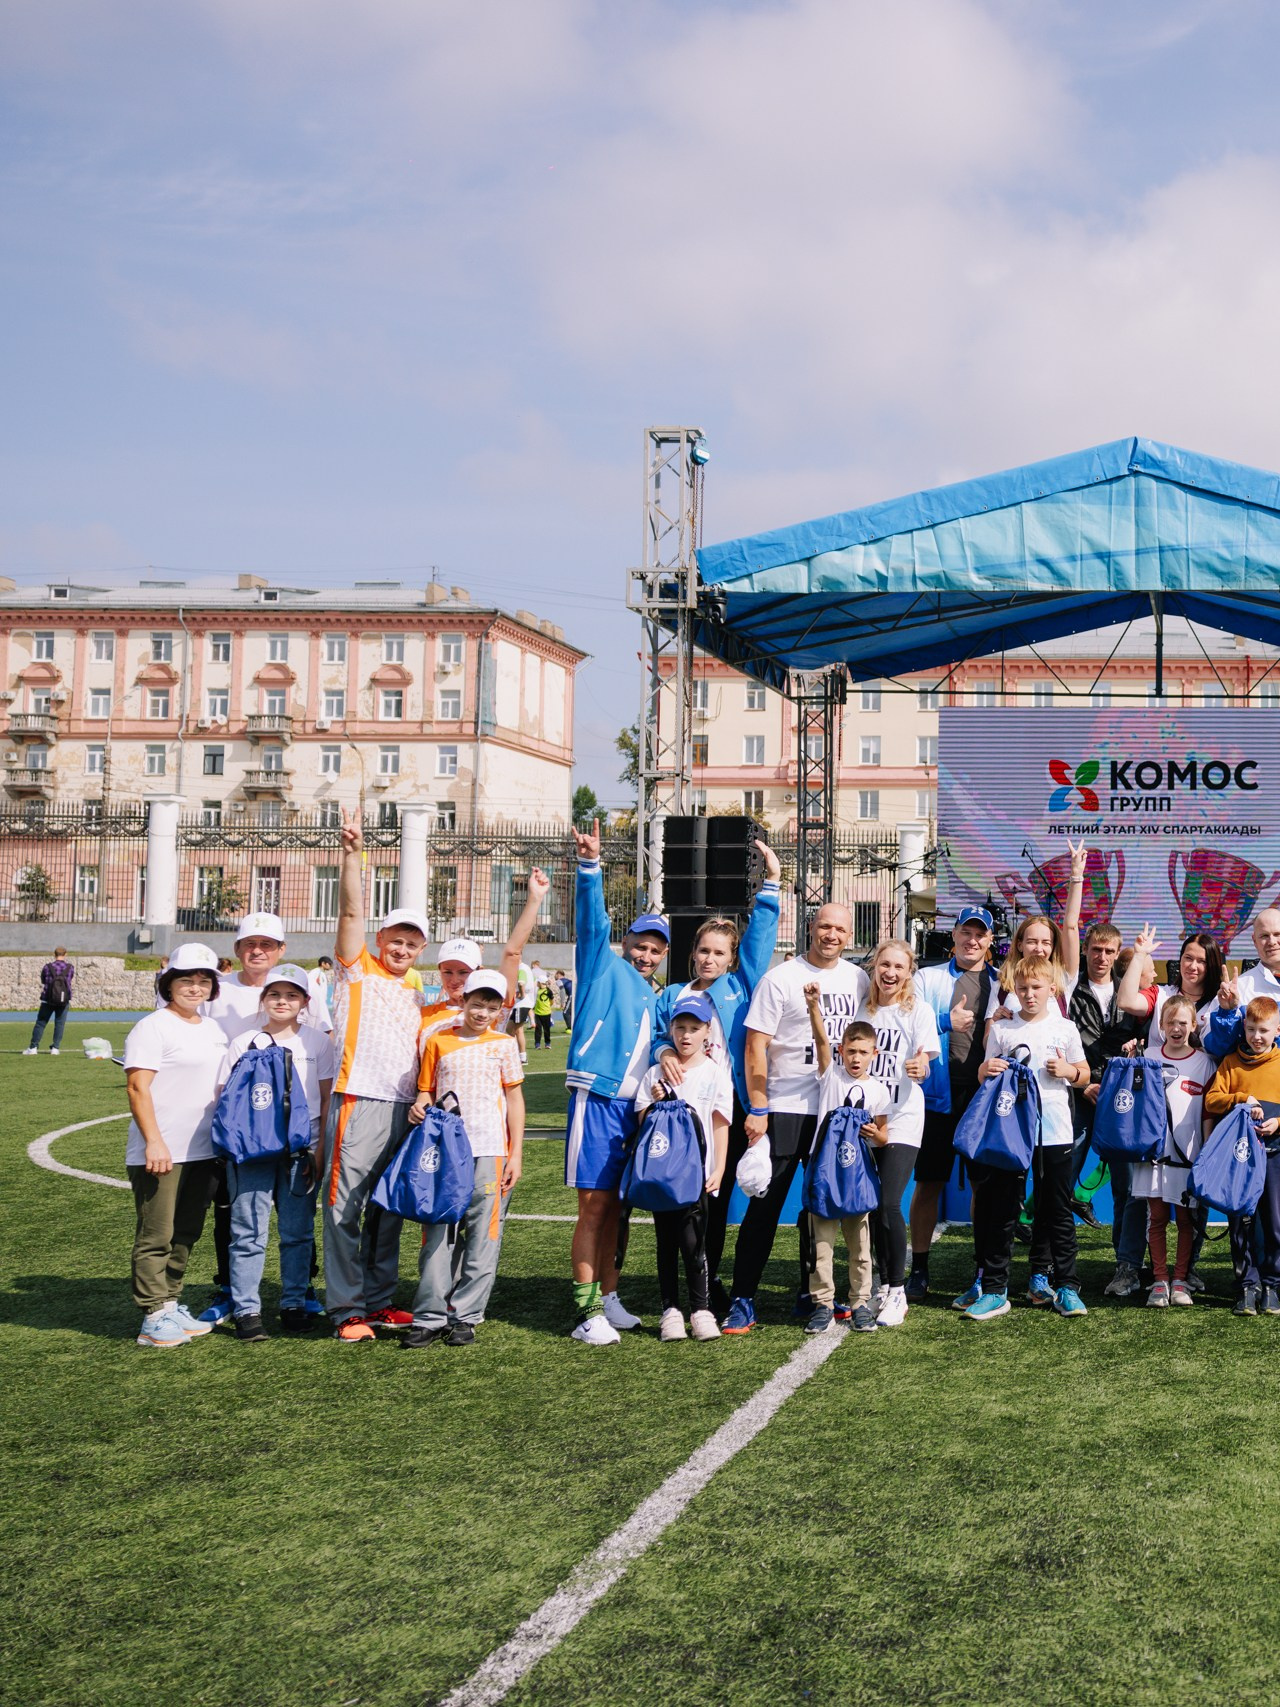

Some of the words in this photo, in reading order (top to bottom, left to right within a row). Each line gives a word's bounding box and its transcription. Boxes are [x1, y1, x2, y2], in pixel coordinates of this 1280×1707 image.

[1110, 760, 1259, 790] КОМОС
[1110, 797, 1171, 812] ГРУПП
[1048, 823, 1099, 835] ЛЕТНИЙ
[1103, 825, 1136, 835] ЭТАП
[1139, 825, 1159, 835] XIV
[1163, 825, 1261, 836] СПАРТАКИАДЫ
